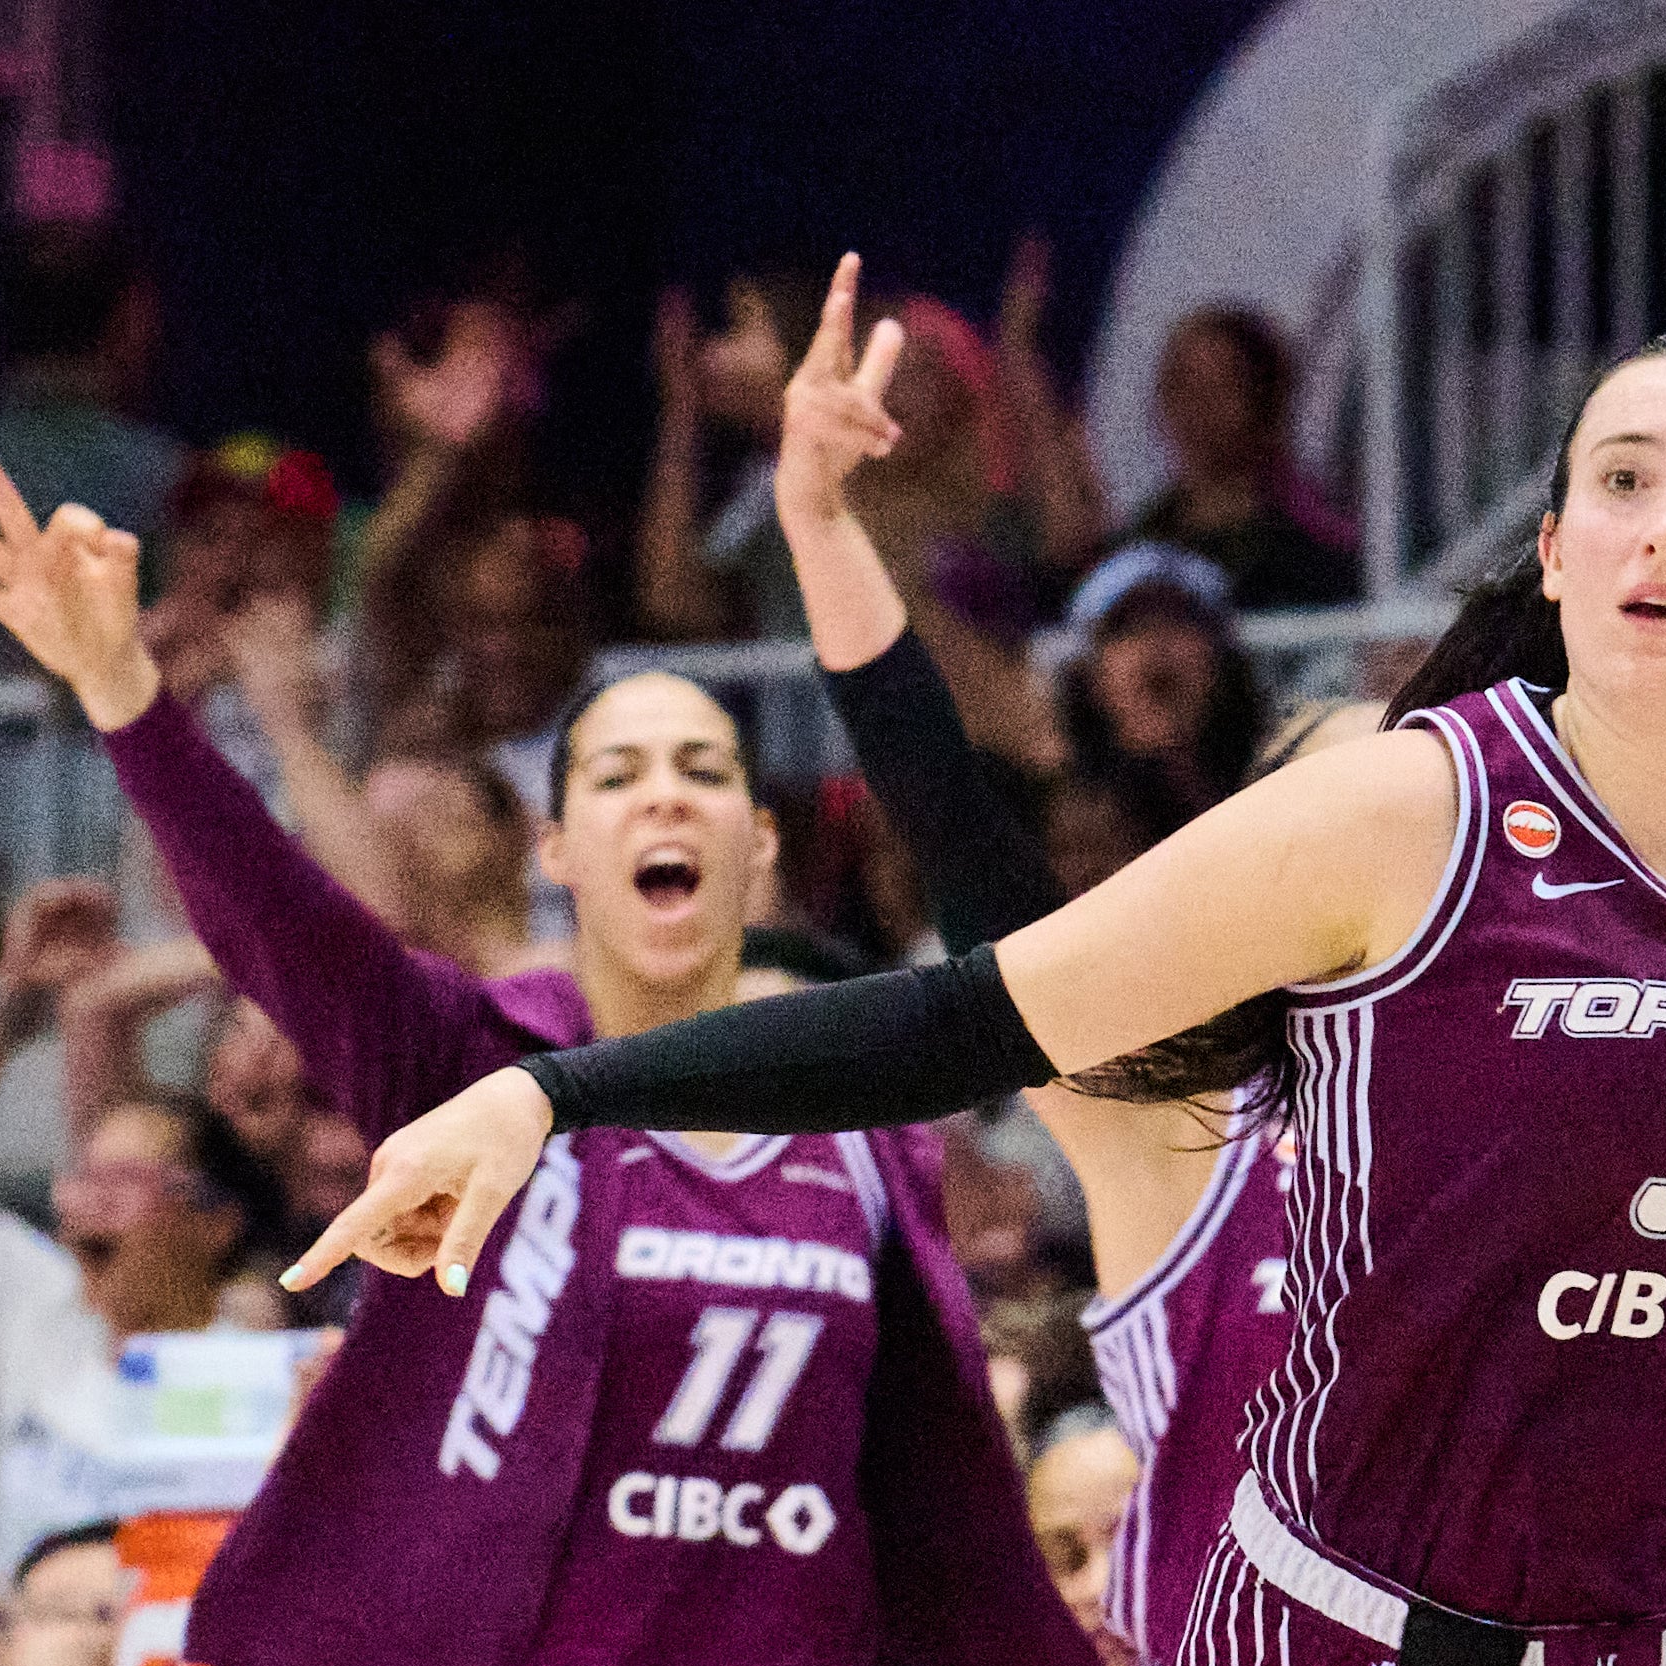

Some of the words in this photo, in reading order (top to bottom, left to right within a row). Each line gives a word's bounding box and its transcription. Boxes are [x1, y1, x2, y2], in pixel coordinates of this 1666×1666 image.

[615, 1224, 872, 1303] ORONTO
[651, 1305, 826, 1453] 11
[606, 1469, 766, 1547] CIBC
